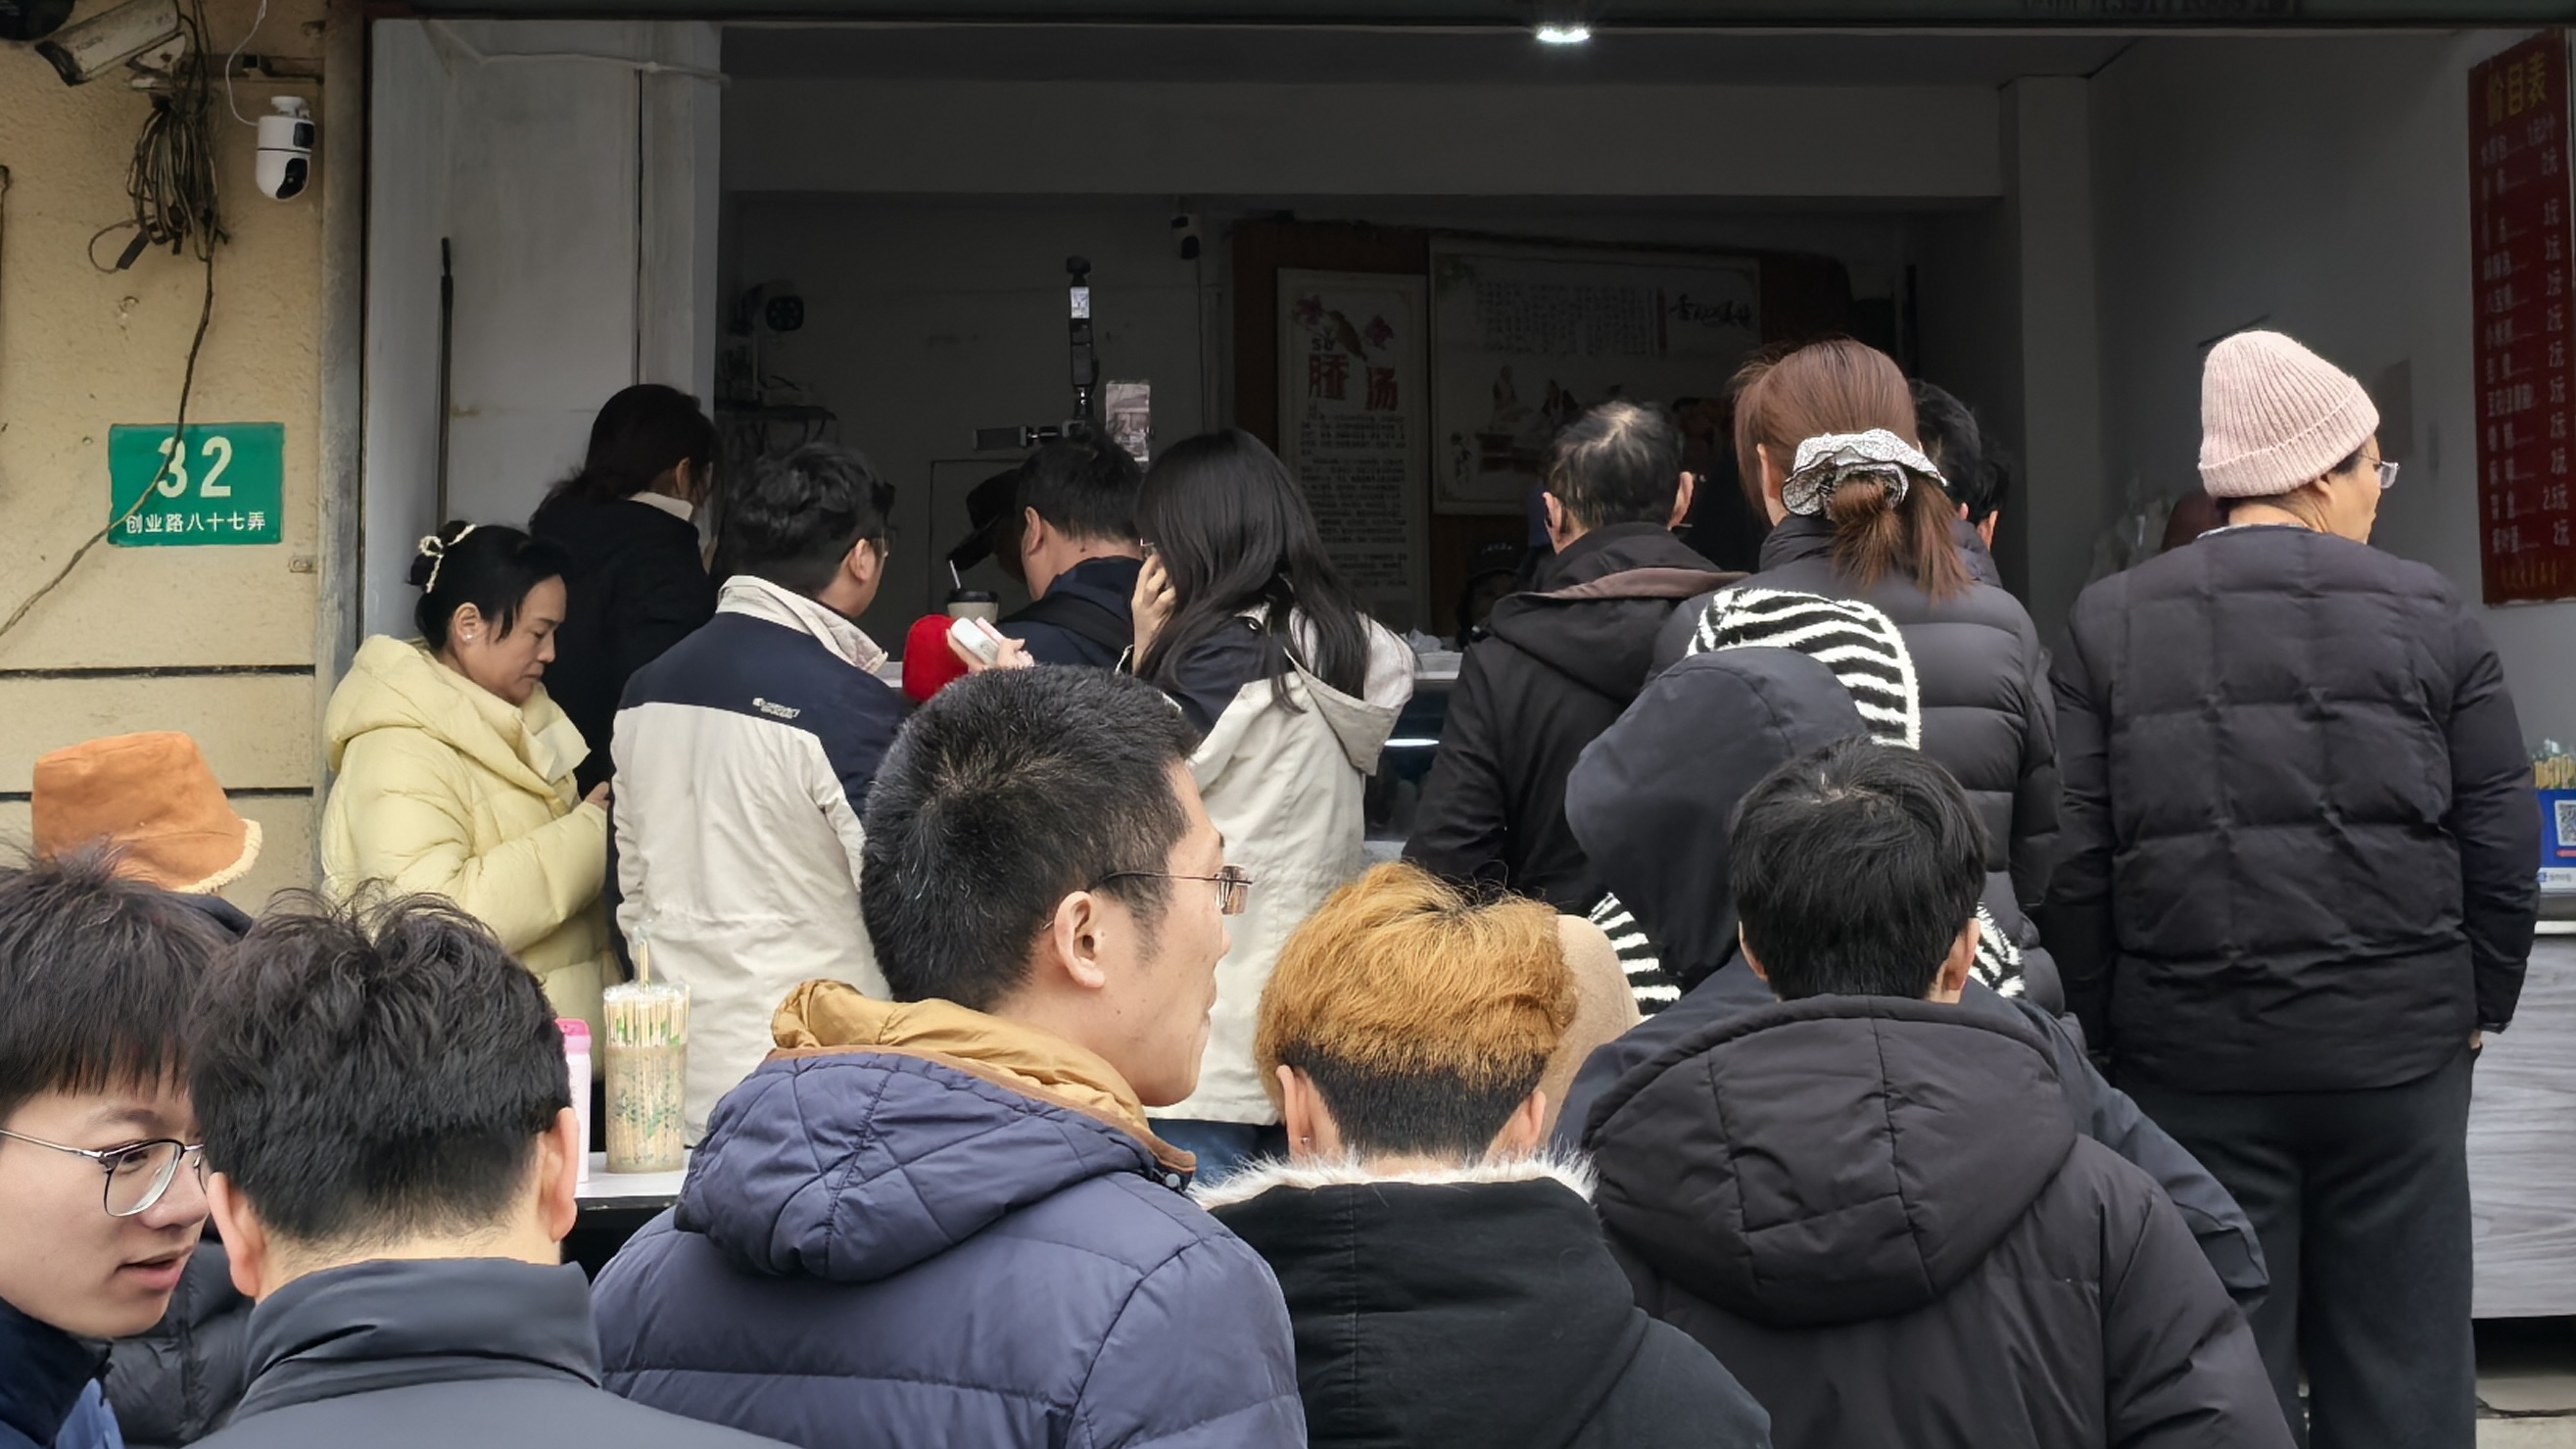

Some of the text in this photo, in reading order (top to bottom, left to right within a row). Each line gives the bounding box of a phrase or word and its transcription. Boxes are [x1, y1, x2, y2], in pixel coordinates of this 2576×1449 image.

[157, 435, 233, 499] 32
[125, 510, 266, 535] 创业路八十七弄
